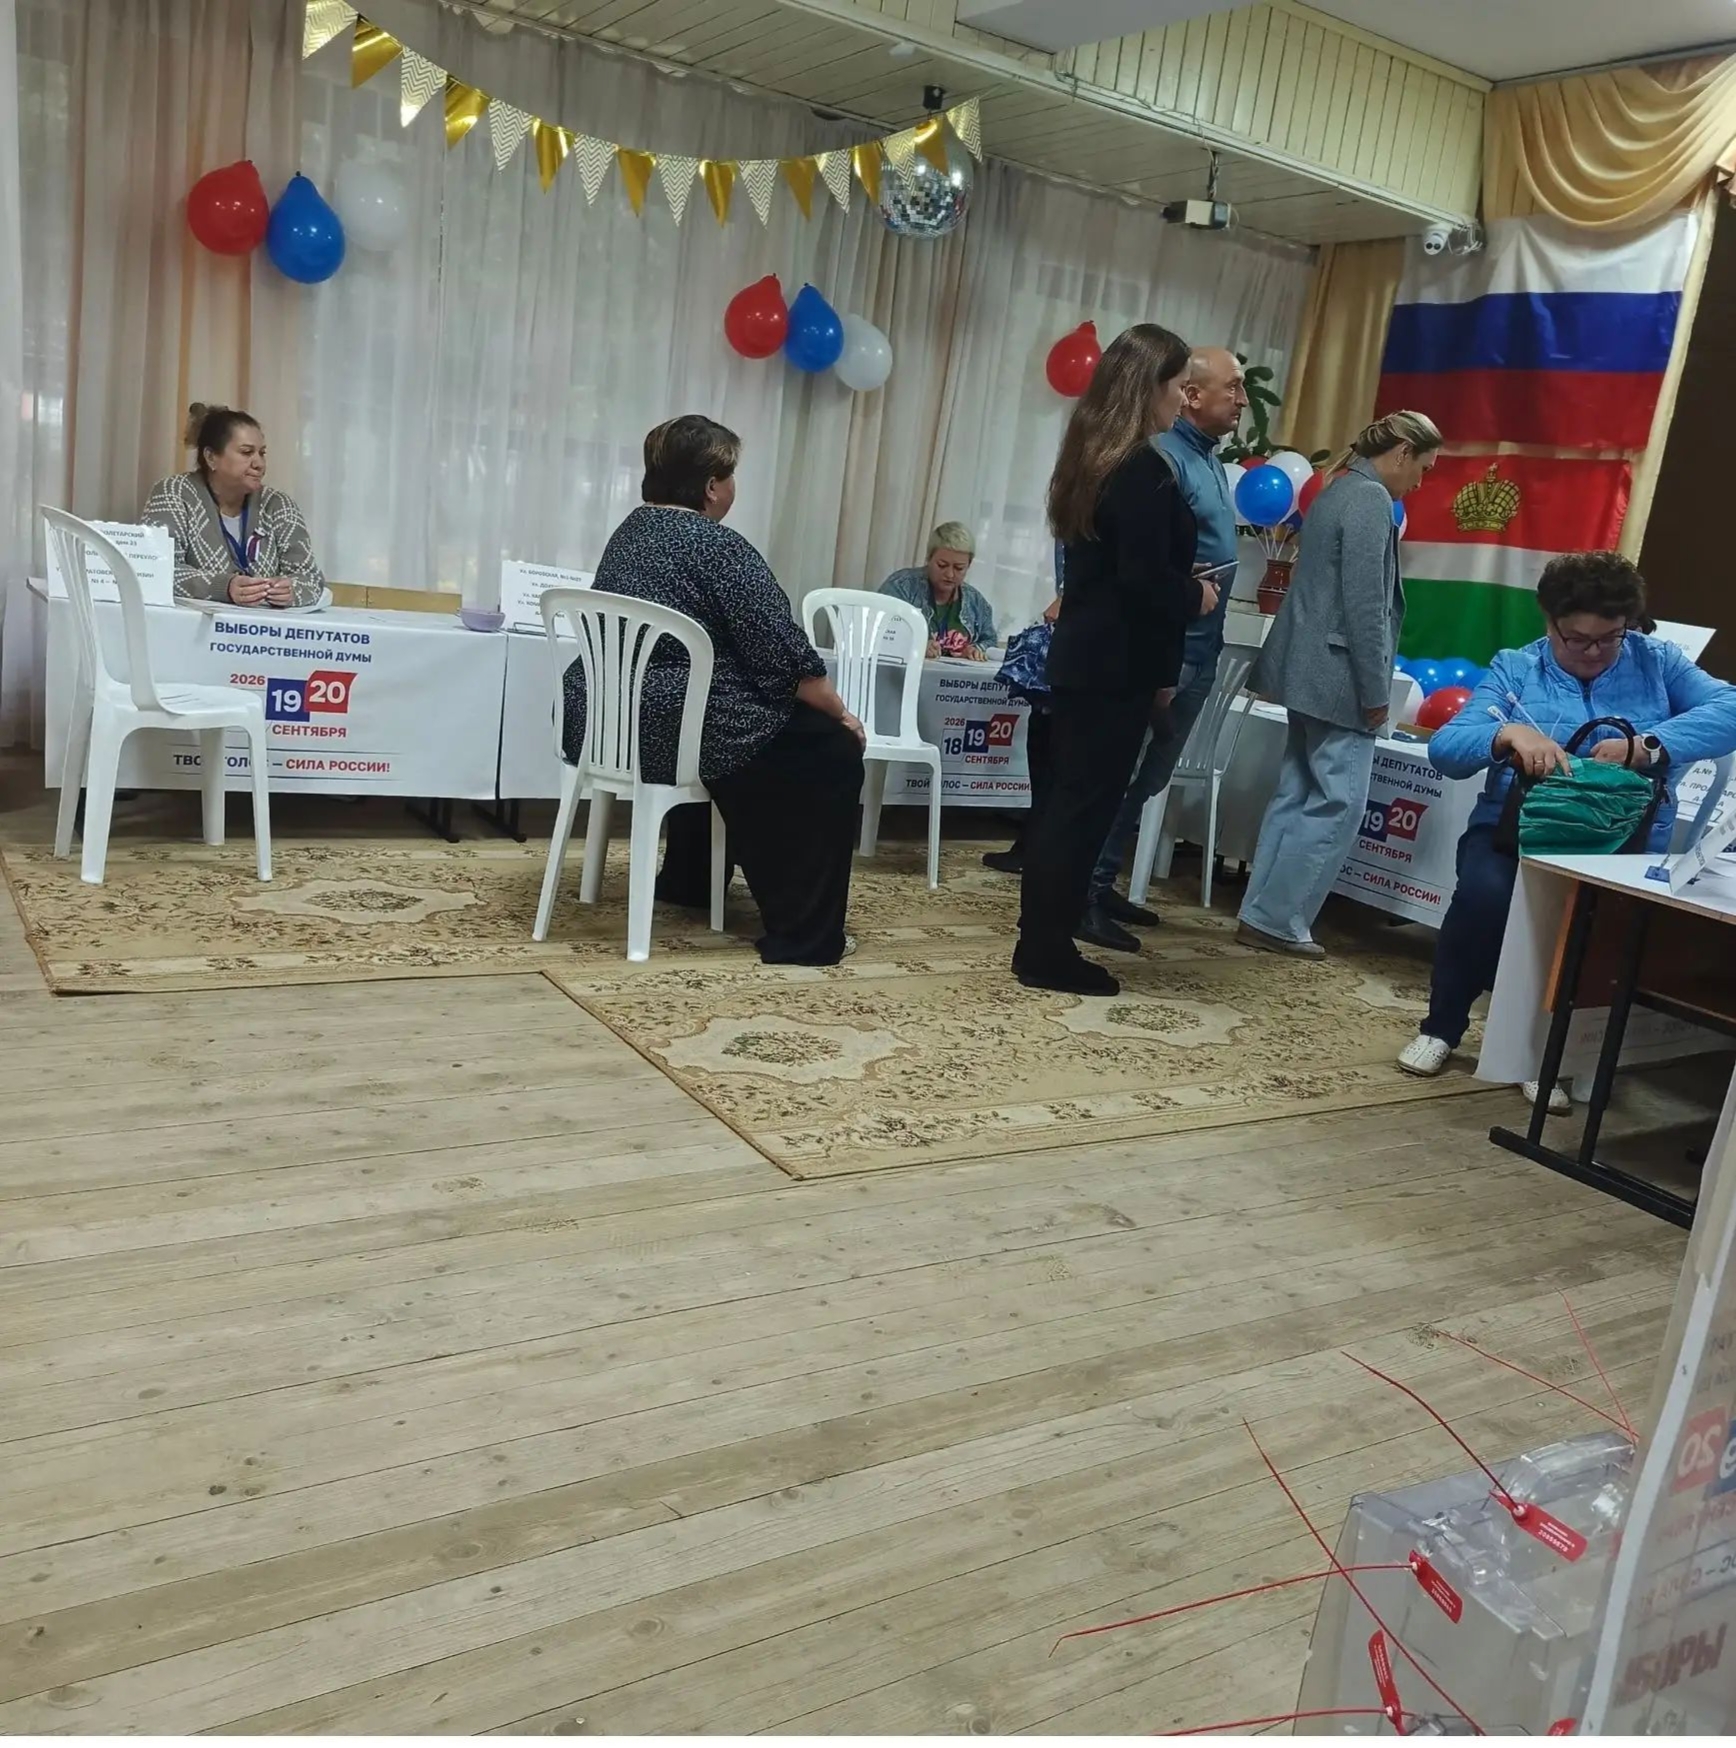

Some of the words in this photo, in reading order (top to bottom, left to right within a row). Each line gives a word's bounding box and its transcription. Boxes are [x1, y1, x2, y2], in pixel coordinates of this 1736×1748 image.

[214, 622, 281, 637] ВЫБОРЫ
[285, 628, 371, 644] ДЕПУТАТОВ
[210, 642, 333, 660] ГОСУДАРСТВЕННОЙ
[335, 652, 372, 663] ДУМЫ
[230, 673, 266, 686] 2026
[940, 679, 979, 689] ВЫБОРЫ
[980, 681, 1011, 692] ДЕПУТ
[271, 689, 302, 713] 19
[309, 680, 346, 704] 20
[935, 694, 1007, 705] ГОСУДАРСТВЕННОЙ
[944, 717, 965, 726] 2026
[272, 724, 347, 738] СЕНТЯБРЯ
[943, 738, 962, 755] 18
[967, 729, 985, 746] 19
[989, 721, 1012, 738] 20
[173, 754, 201, 766] ТВО
[286, 759, 325, 770] СИЛА
[329, 760, 390, 772] РОССИИ!
[965, 755, 1009, 765] СЕНТЯБРЯ
[1381, 757, 1443, 781] ДЕПУТАТОВ
[906, 778, 930, 788] ТВОЙ
[970, 781, 993, 790] СИЛА
[1413, 784, 1442, 798] ДУМЫ
[1363, 809, 1384, 832] 19
[1388, 806, 1416, 831] 20
[1359, 839, 1413, 864] СЕНТЯБРЯ
[1363, 872, 1391, 889] СИЛА
[1393, 882, 1442, 905] РОССИИ!
